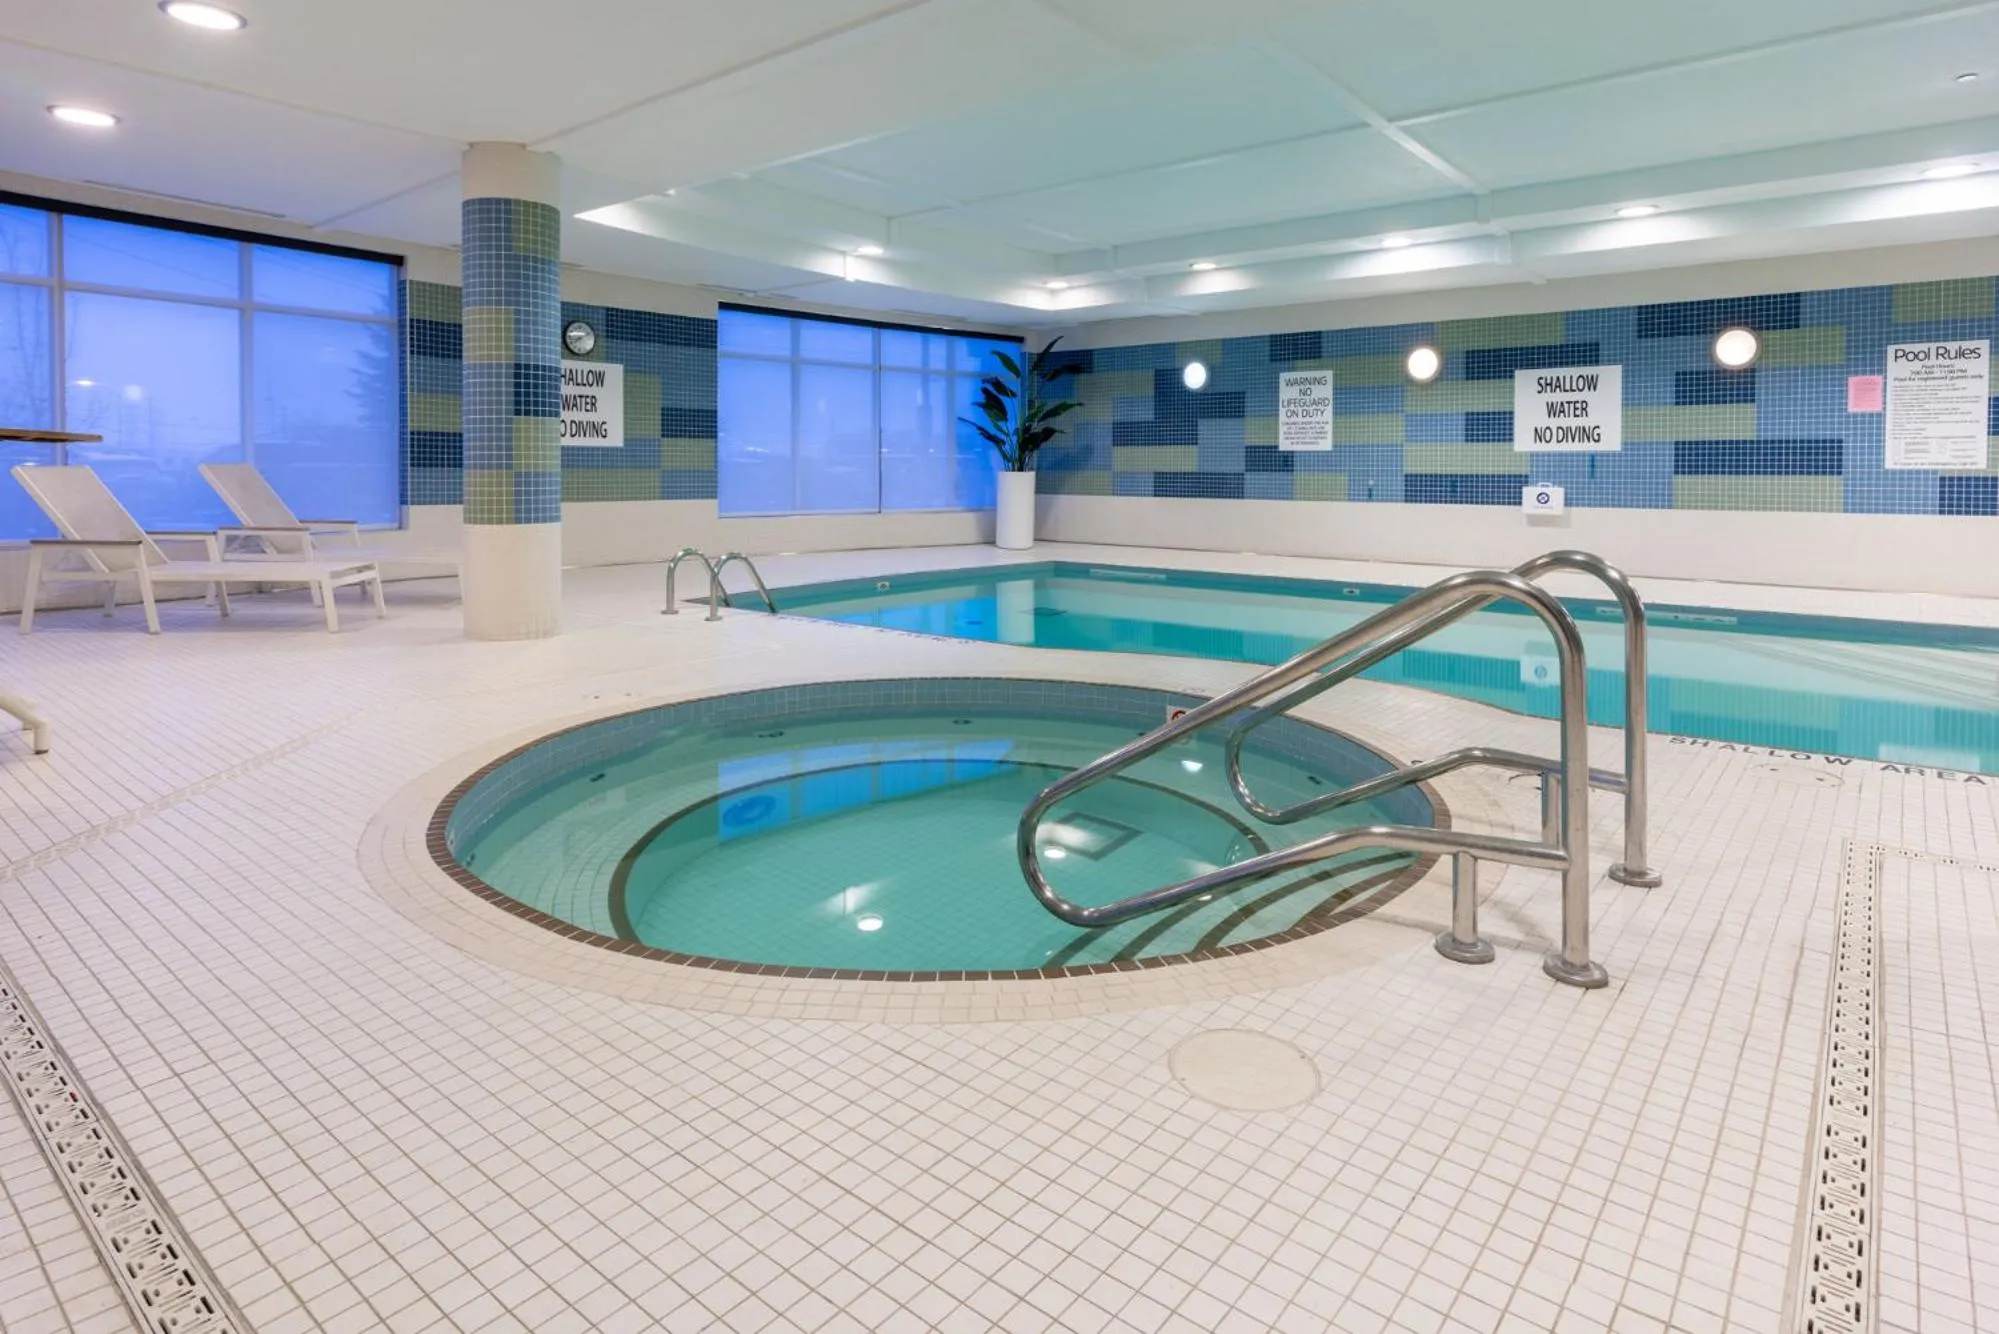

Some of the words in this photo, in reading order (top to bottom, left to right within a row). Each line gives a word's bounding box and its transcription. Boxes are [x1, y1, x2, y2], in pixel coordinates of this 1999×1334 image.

[1894, 347, 1931, 362] Pool
[1936, 344, 1982, 360] Rules
[560, 367, 605, 388] HALLOW
[1284, 375, 1328, 387] WARNING
[1537, 374, 1599, 394] SHALLOW
[1299, 387, 1312, 397] NO
[560, 393, 598, 413] WATER
[1281, 397, 1331, 409] LIFEGUARD
[1546, 400, 1589, 418] WATER
[1285, 408, 1299, 418] ON
[1302, 408, 1326, 418] DUTY
[569, 420, 608, 439] DIVING
[1534, 426, 1553, 444] NO
[1556, 425, 1601, 444] DIVING
[1669, 737, 1853, 766] SHALLOW
[1880, 764, 1987, 785] AREA
